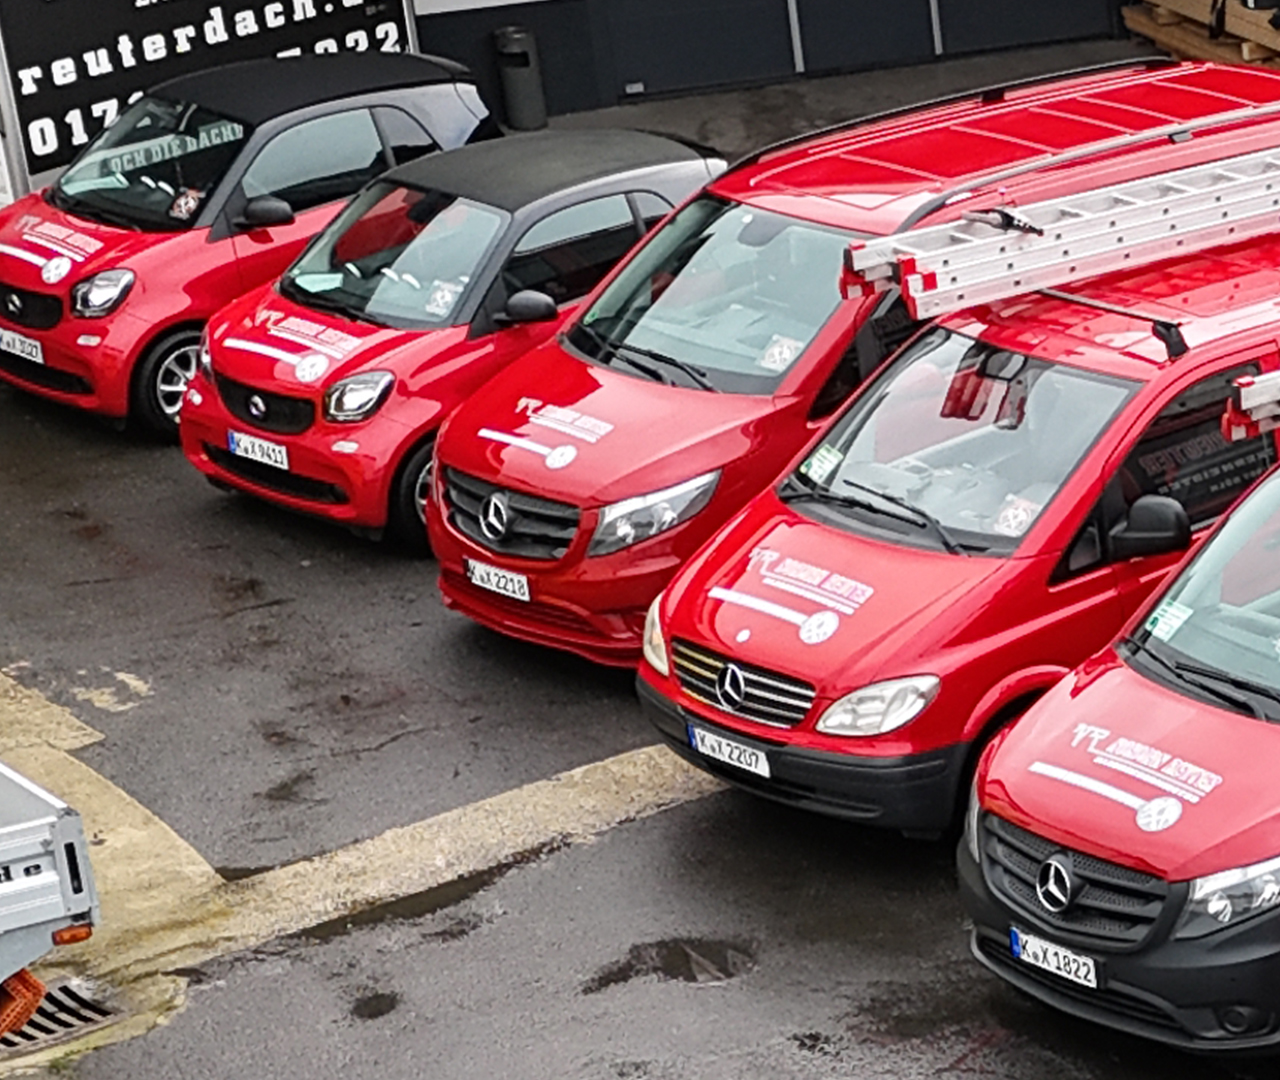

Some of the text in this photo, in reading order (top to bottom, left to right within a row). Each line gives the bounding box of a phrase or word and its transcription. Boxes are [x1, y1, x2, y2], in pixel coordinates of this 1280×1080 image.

[17, 0, 365, 96] reuterdach.
[725, 741, 760, 770] 2207
[1020, 937, 1093, 984] K X 1822
